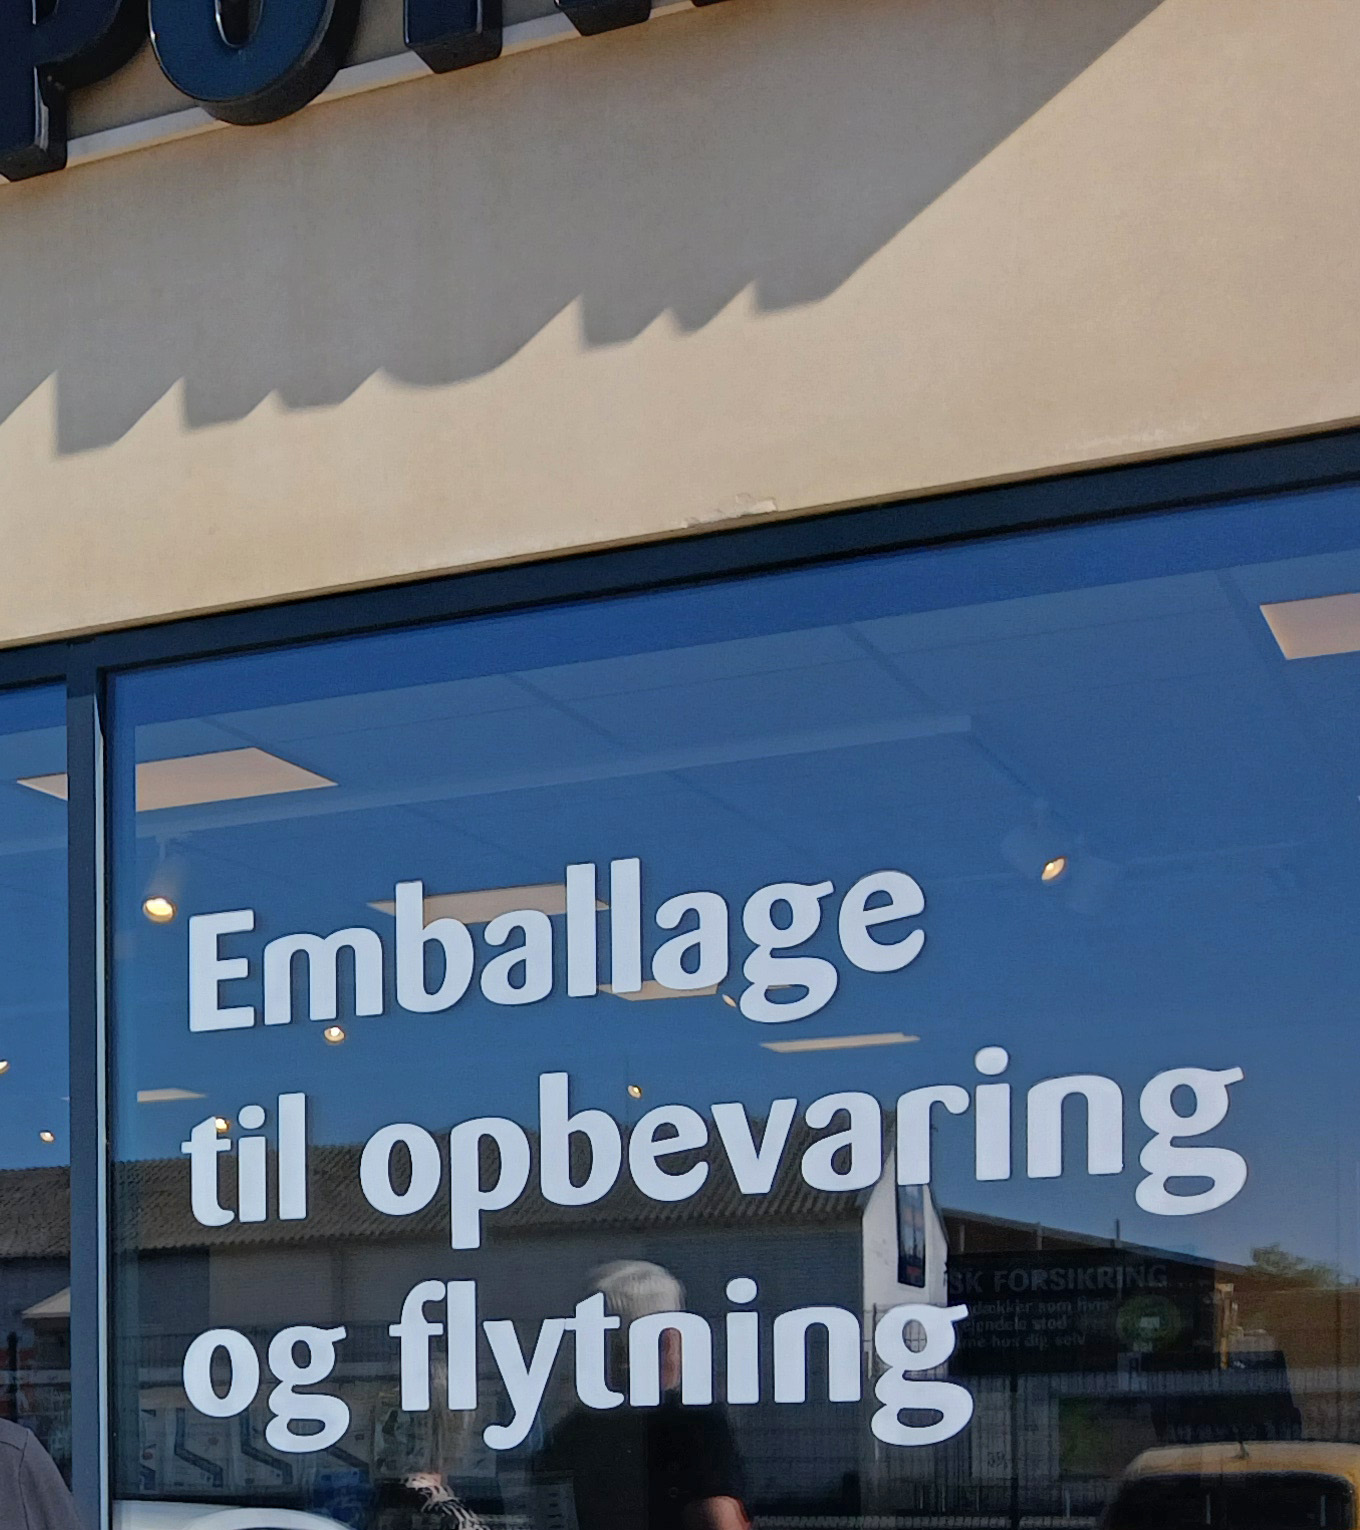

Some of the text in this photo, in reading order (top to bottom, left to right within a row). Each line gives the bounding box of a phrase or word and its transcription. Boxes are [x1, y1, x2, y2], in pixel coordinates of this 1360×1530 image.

[188, 857, 926, 1034] Emballage
[182, 1045, 1248, 1251] til opbevaring
[182, 1277, 975, 1454] og flytning
[993, 1264, 1167, 1293] FORSIKRING
